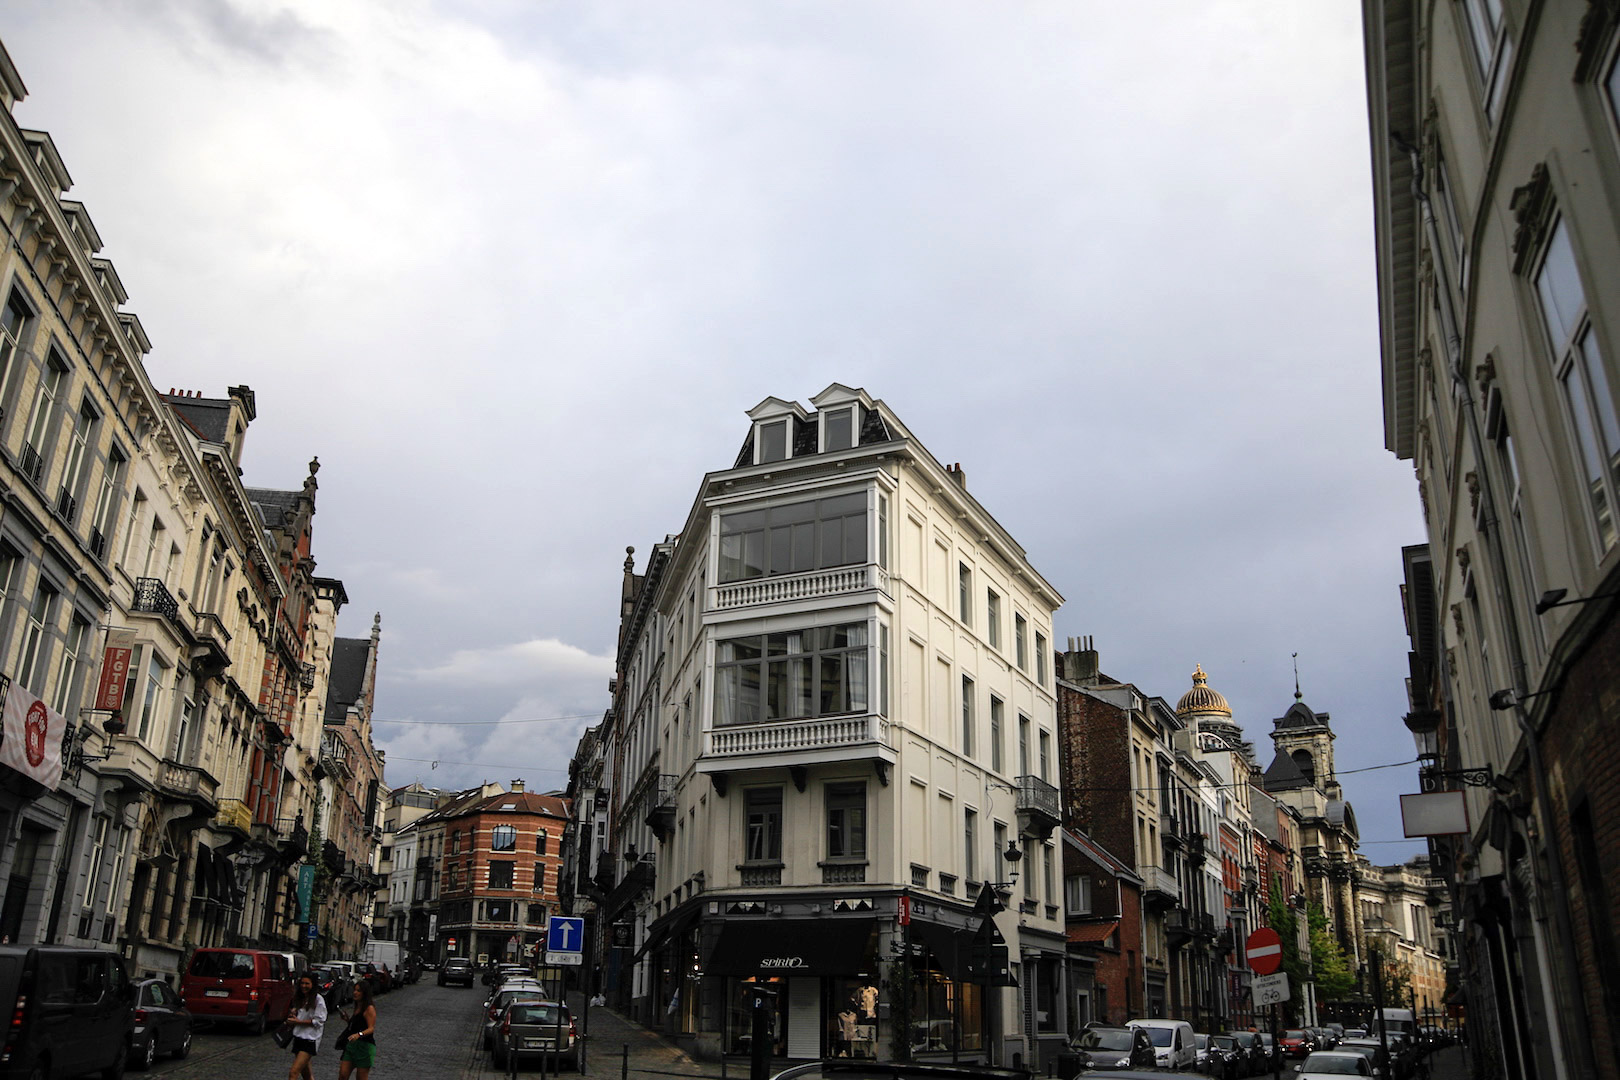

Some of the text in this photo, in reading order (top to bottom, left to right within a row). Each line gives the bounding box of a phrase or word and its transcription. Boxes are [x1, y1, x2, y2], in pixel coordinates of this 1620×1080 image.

[109, 649, 126, 695] FGTB
[309, 925, 316, 935] P
[755, 997, 762, 1008] P
